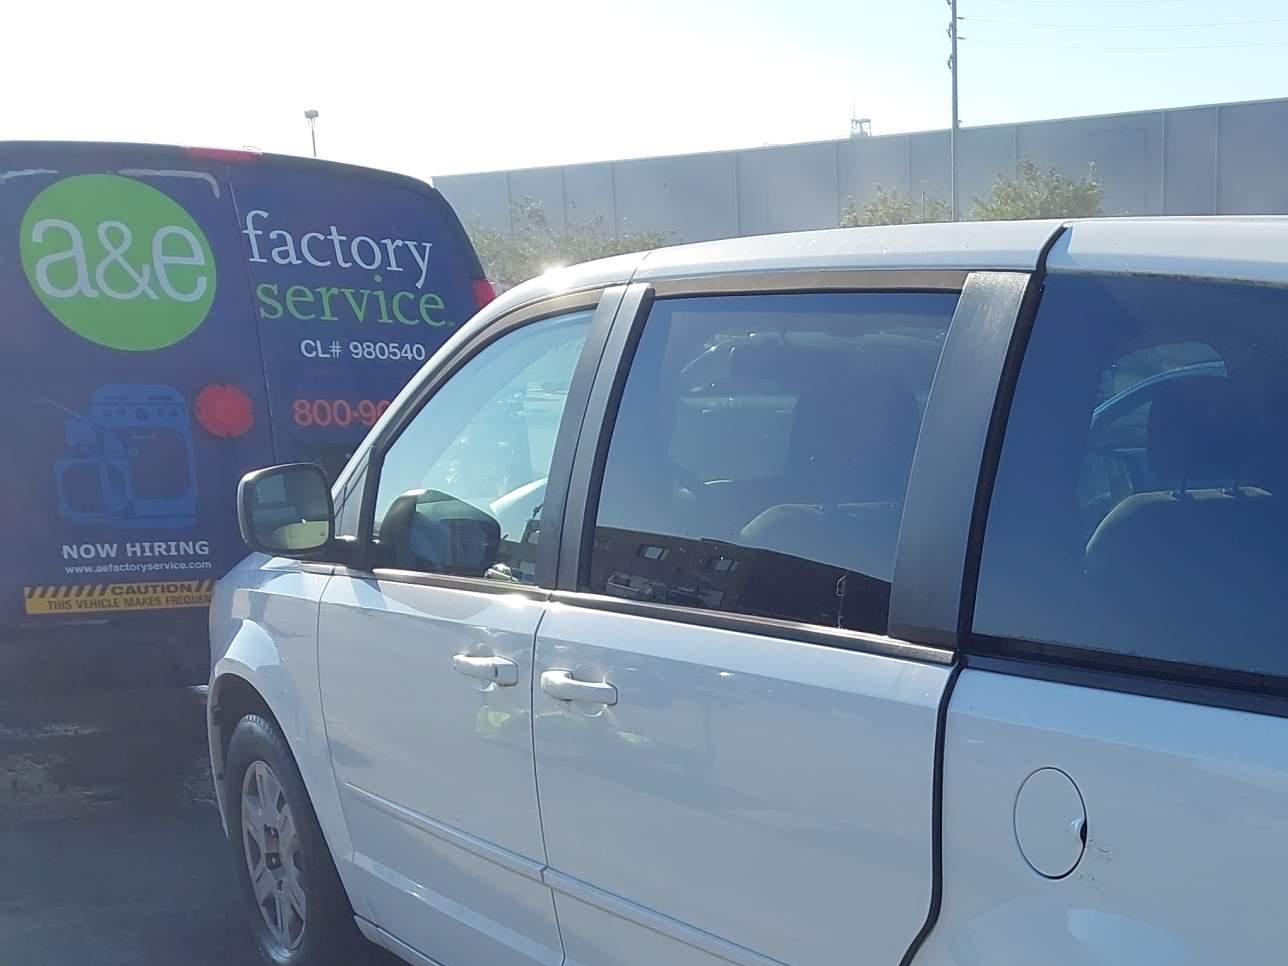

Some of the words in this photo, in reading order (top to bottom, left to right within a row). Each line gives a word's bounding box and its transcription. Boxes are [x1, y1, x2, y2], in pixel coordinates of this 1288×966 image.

[31, 218, 208, 302] a&e
[242, 210, 433, 289] factory
[256, 274, 446, 327] service
[300, 339, 342, 359] CL#
[349, 341, 426, 361] 980540
[62, 543, 118, 560] NOW
[126, 540, 210, 557] HIRING
[64, 560, 212, 574] www.aefactoryservice.com
[110, 583, 193, 596] CAUTION
[48, 599, 73, 611] THIS
[77, 597, 121, 609] VEHICLE
[123, 595, 162, 607] MAKES
